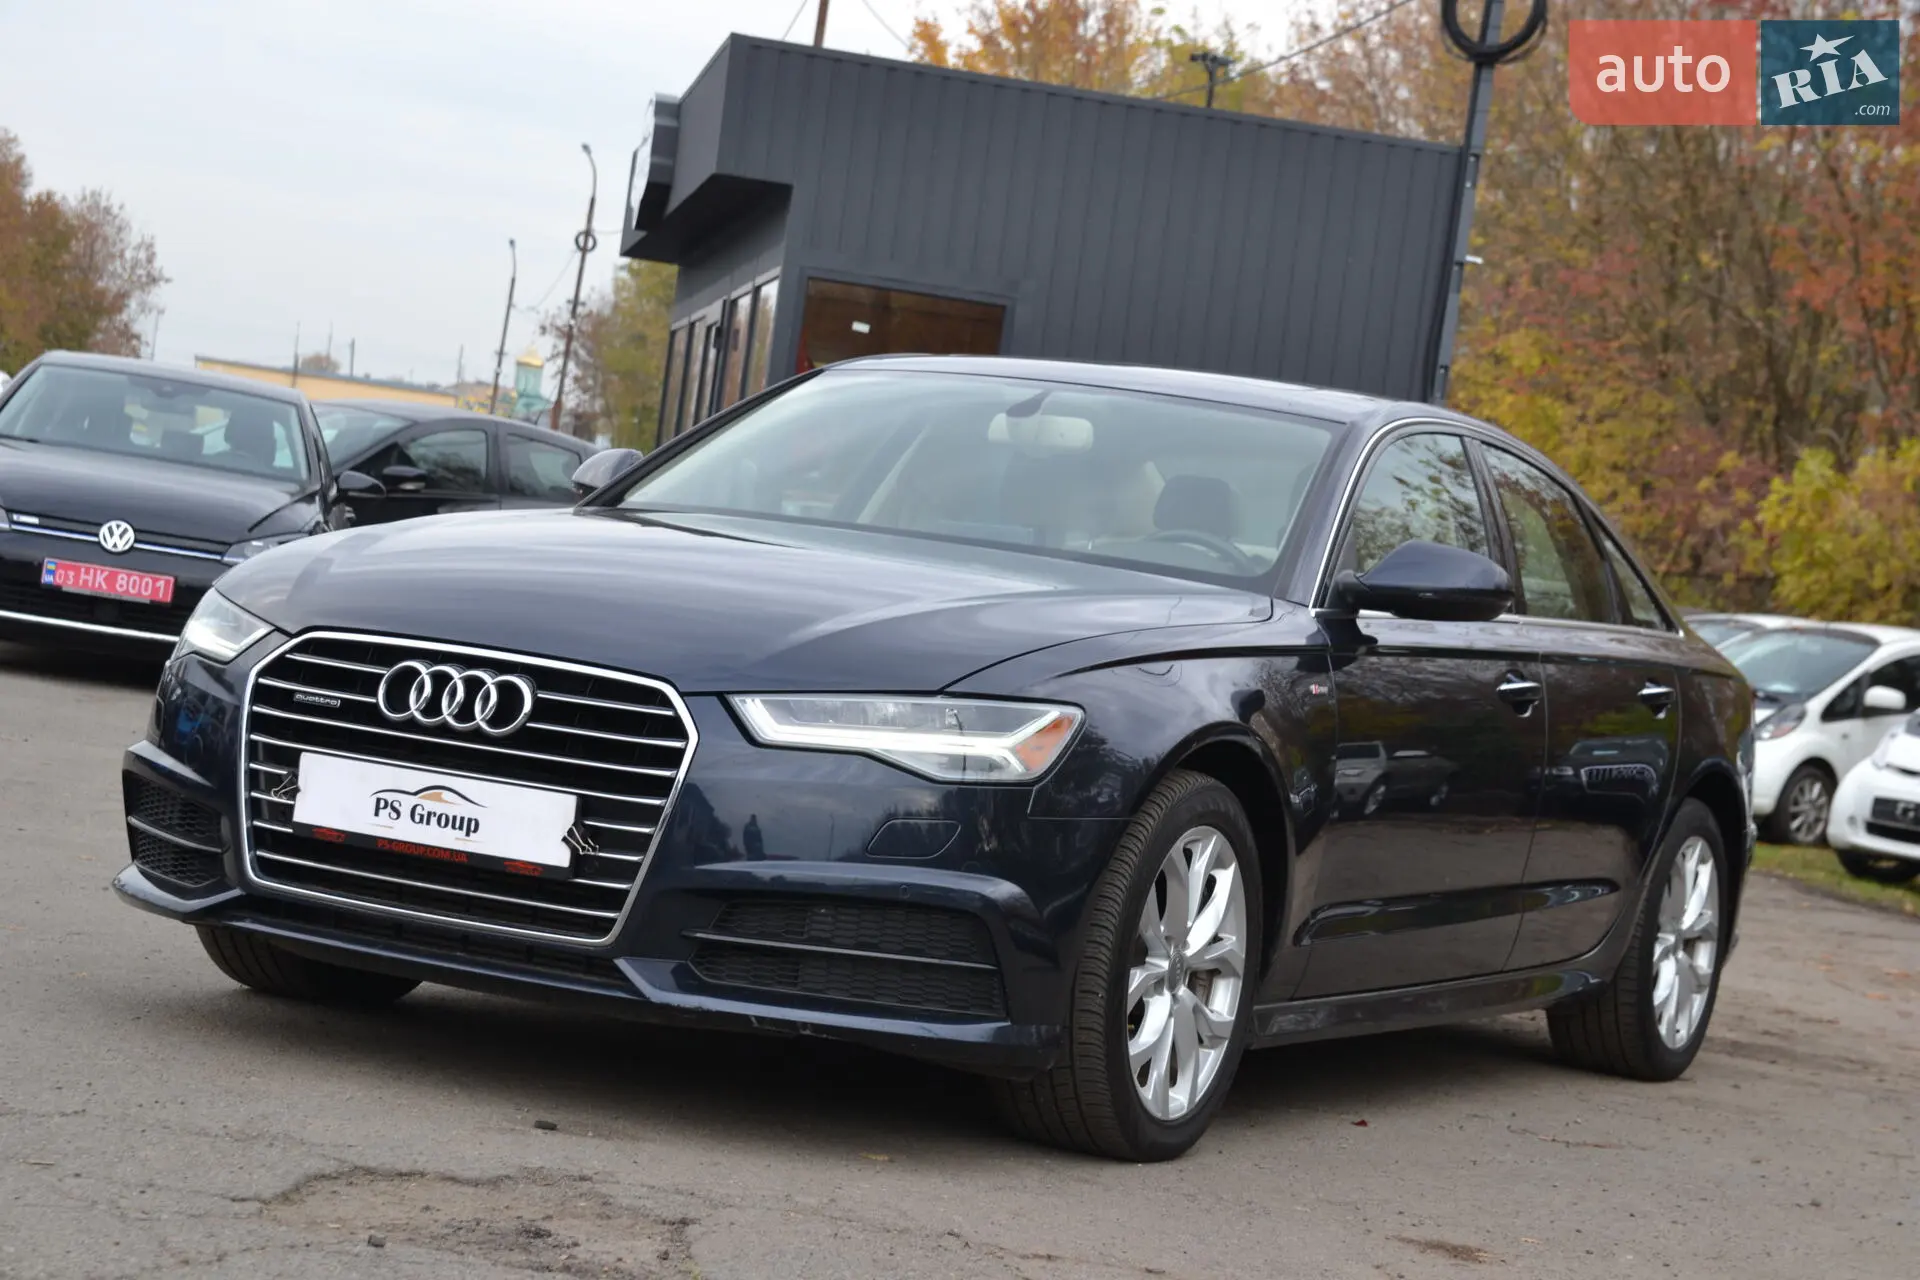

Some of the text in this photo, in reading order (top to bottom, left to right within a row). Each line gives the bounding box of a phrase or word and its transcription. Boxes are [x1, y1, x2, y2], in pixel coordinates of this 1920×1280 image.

[79, 567, 108, 590] HK
[115, 574, 165, 598] 8001
[295, 694, 338, 706] quattro
[373, 797, 480, 838] PS Group
